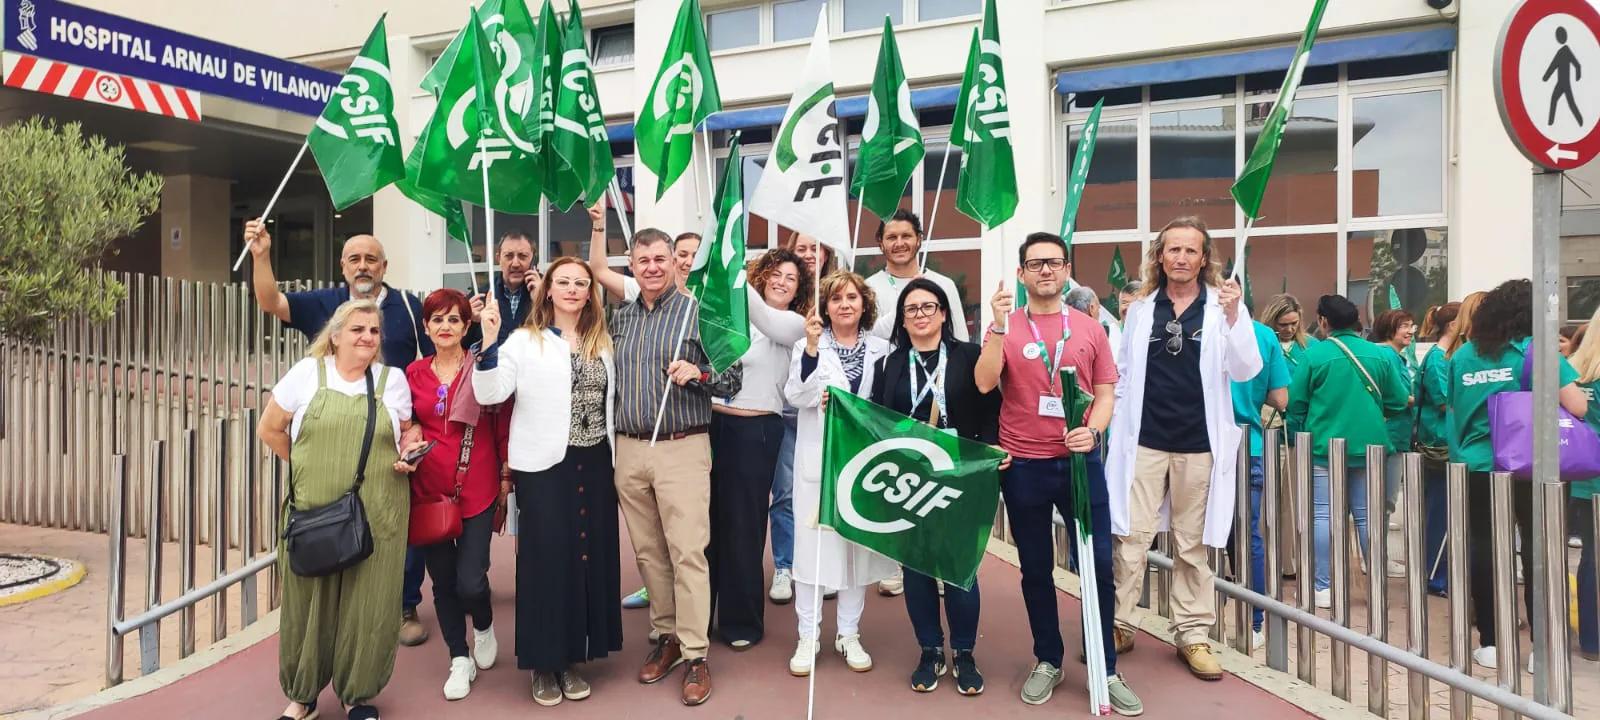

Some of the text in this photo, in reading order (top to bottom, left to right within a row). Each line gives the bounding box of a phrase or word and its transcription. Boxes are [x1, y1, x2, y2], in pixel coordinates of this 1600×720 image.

[50, 16, 157, 63] HOSPITAL
[161, 44, 227, 80] ARNAU
[233, 61, 257, 87] DE
[339, 73, 396, 147] CSIF
[1462, 367, 1514, 387] SATSE
[861, 461, 964, 518] CSIF
